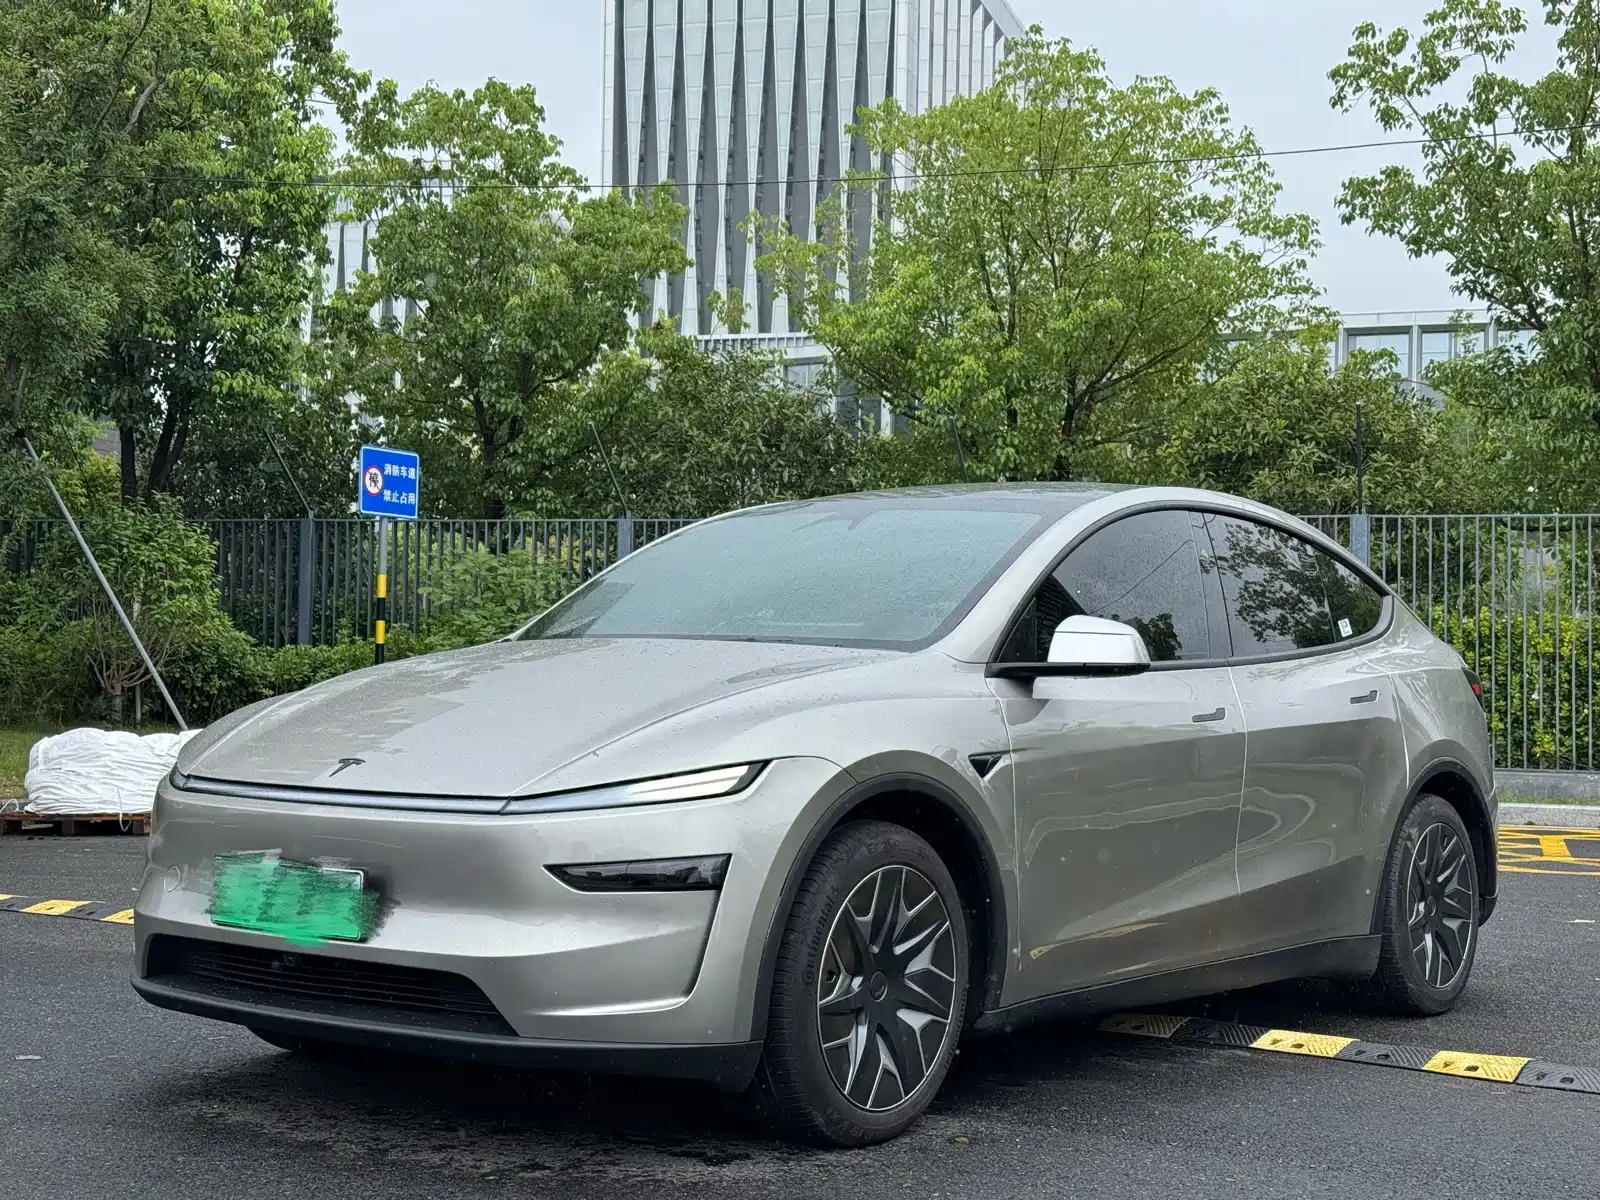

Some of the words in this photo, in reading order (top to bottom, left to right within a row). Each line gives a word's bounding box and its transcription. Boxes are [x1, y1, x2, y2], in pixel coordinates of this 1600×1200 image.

[384, 463, 416, 479] 消防车道
[383, 489, 416, 504] 禁止占用
[804, 895, 836, 985] Continental
